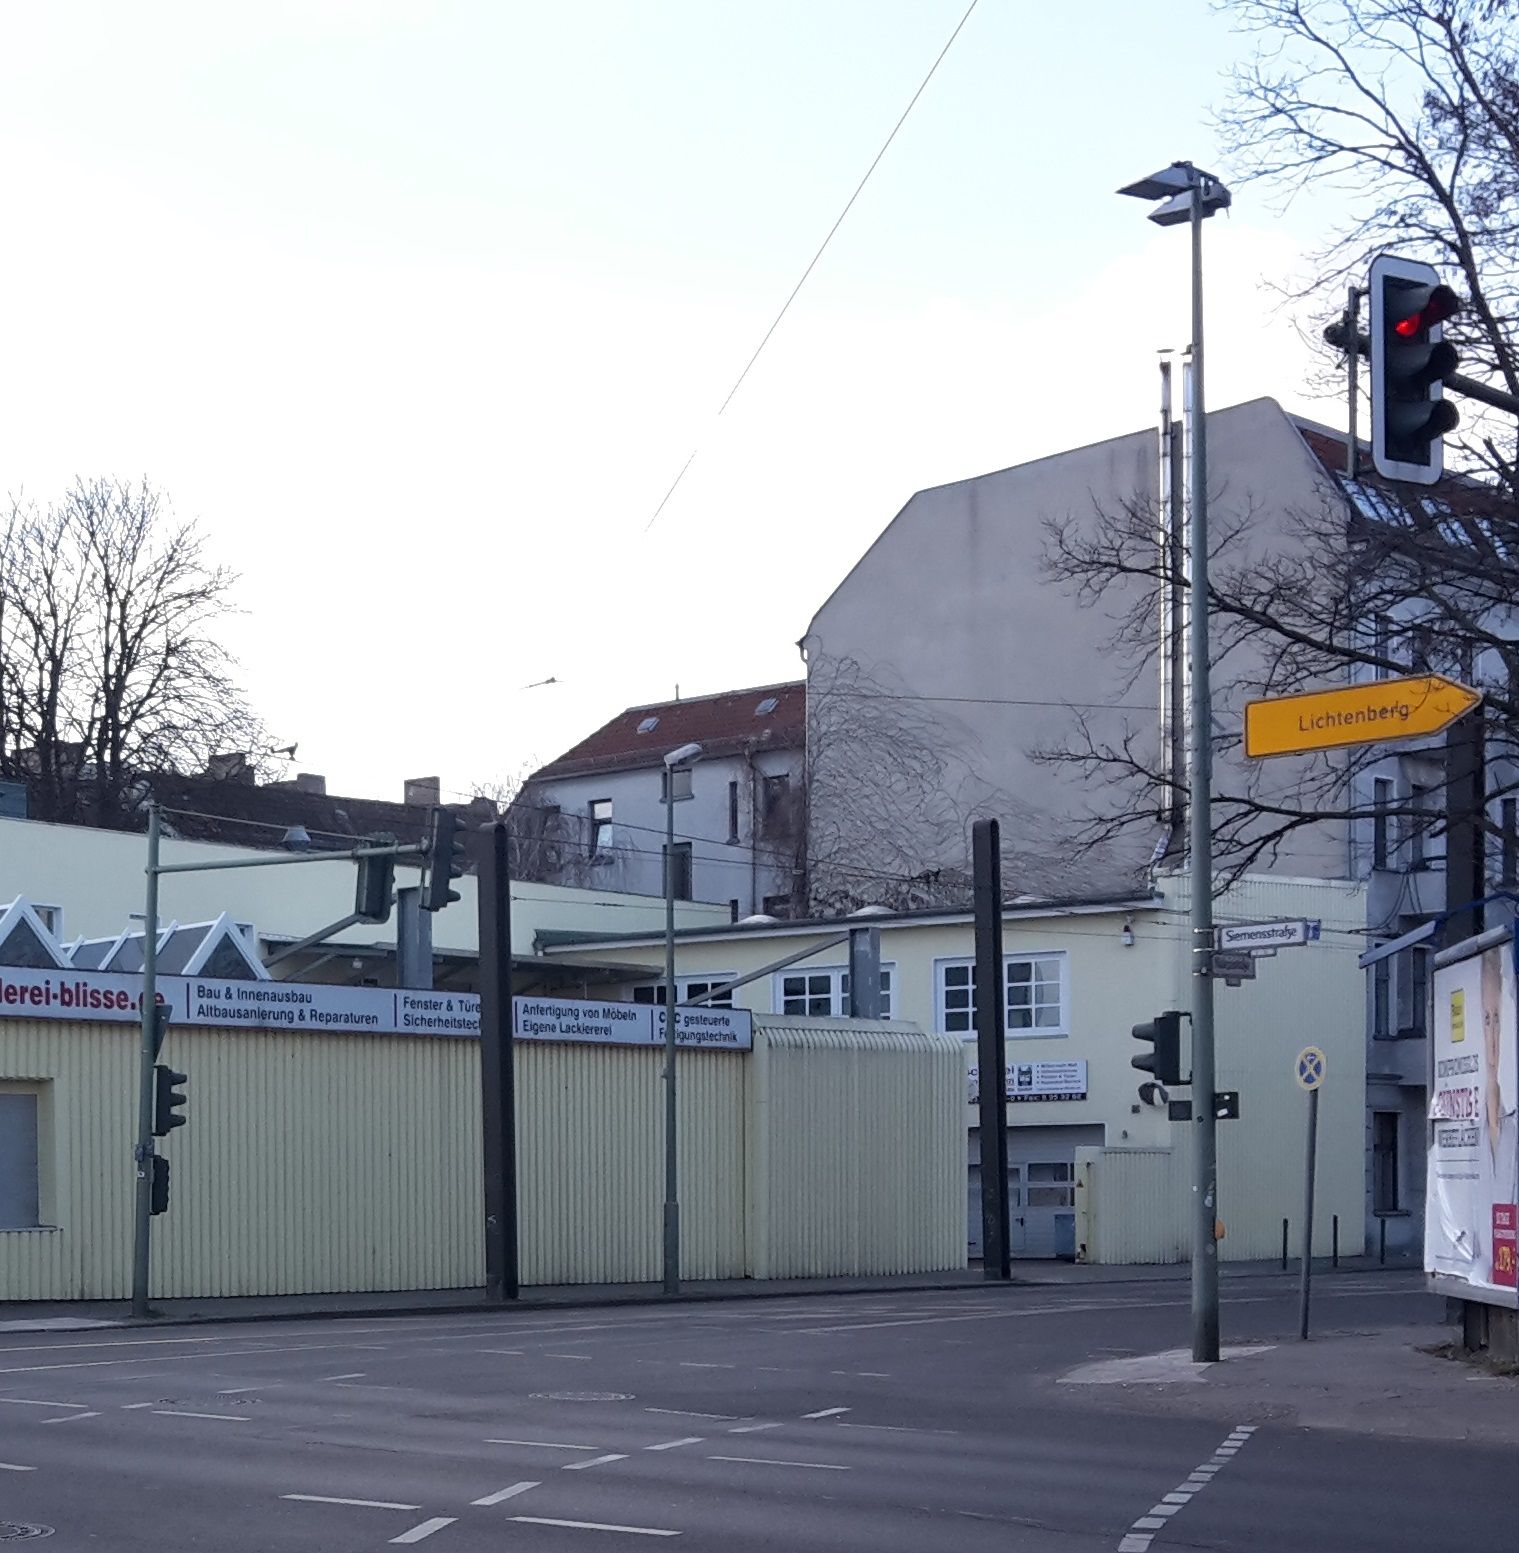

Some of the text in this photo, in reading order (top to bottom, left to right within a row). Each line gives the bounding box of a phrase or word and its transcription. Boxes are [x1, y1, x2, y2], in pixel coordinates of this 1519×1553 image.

[1298, 701, 1410, 731] Lichtenberg
[197, 985, 313, 1004] Bau & Innenausbau
[403, 996, 480, 1013] Fenster & Türe
[522, 1003, 637, 1021] Anfertigung von Möbeln
[197, 1004, 379, 1025] Altbausanierung & Reparaturen
[403, 1013, 480, 1030] Sicherheitstec
[659, 1011, 730, 1027] CC gesteuerte
[523, 1022, 612, 1036] Eigene Lackiererei
[659, 1027, 737, 1044] Figungstechnik
